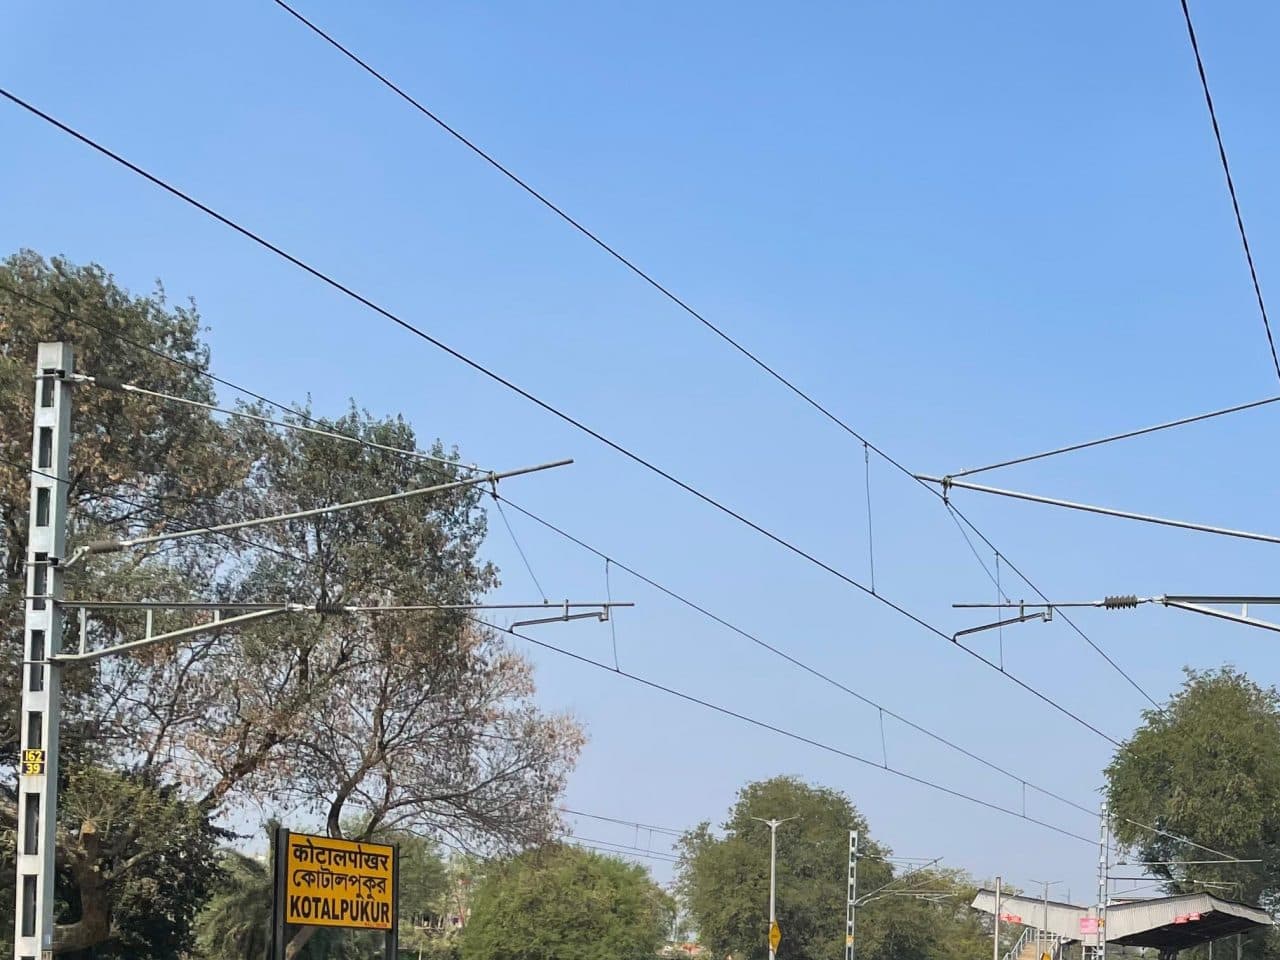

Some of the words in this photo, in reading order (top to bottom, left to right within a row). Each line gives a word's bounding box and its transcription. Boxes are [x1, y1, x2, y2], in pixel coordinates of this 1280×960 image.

[292, 838, 389, 871] कोटालपोखर
[293, 866, 387, 900] কোটালপুকুর
[290, 895, 390, 923] KOTALPUKUR
